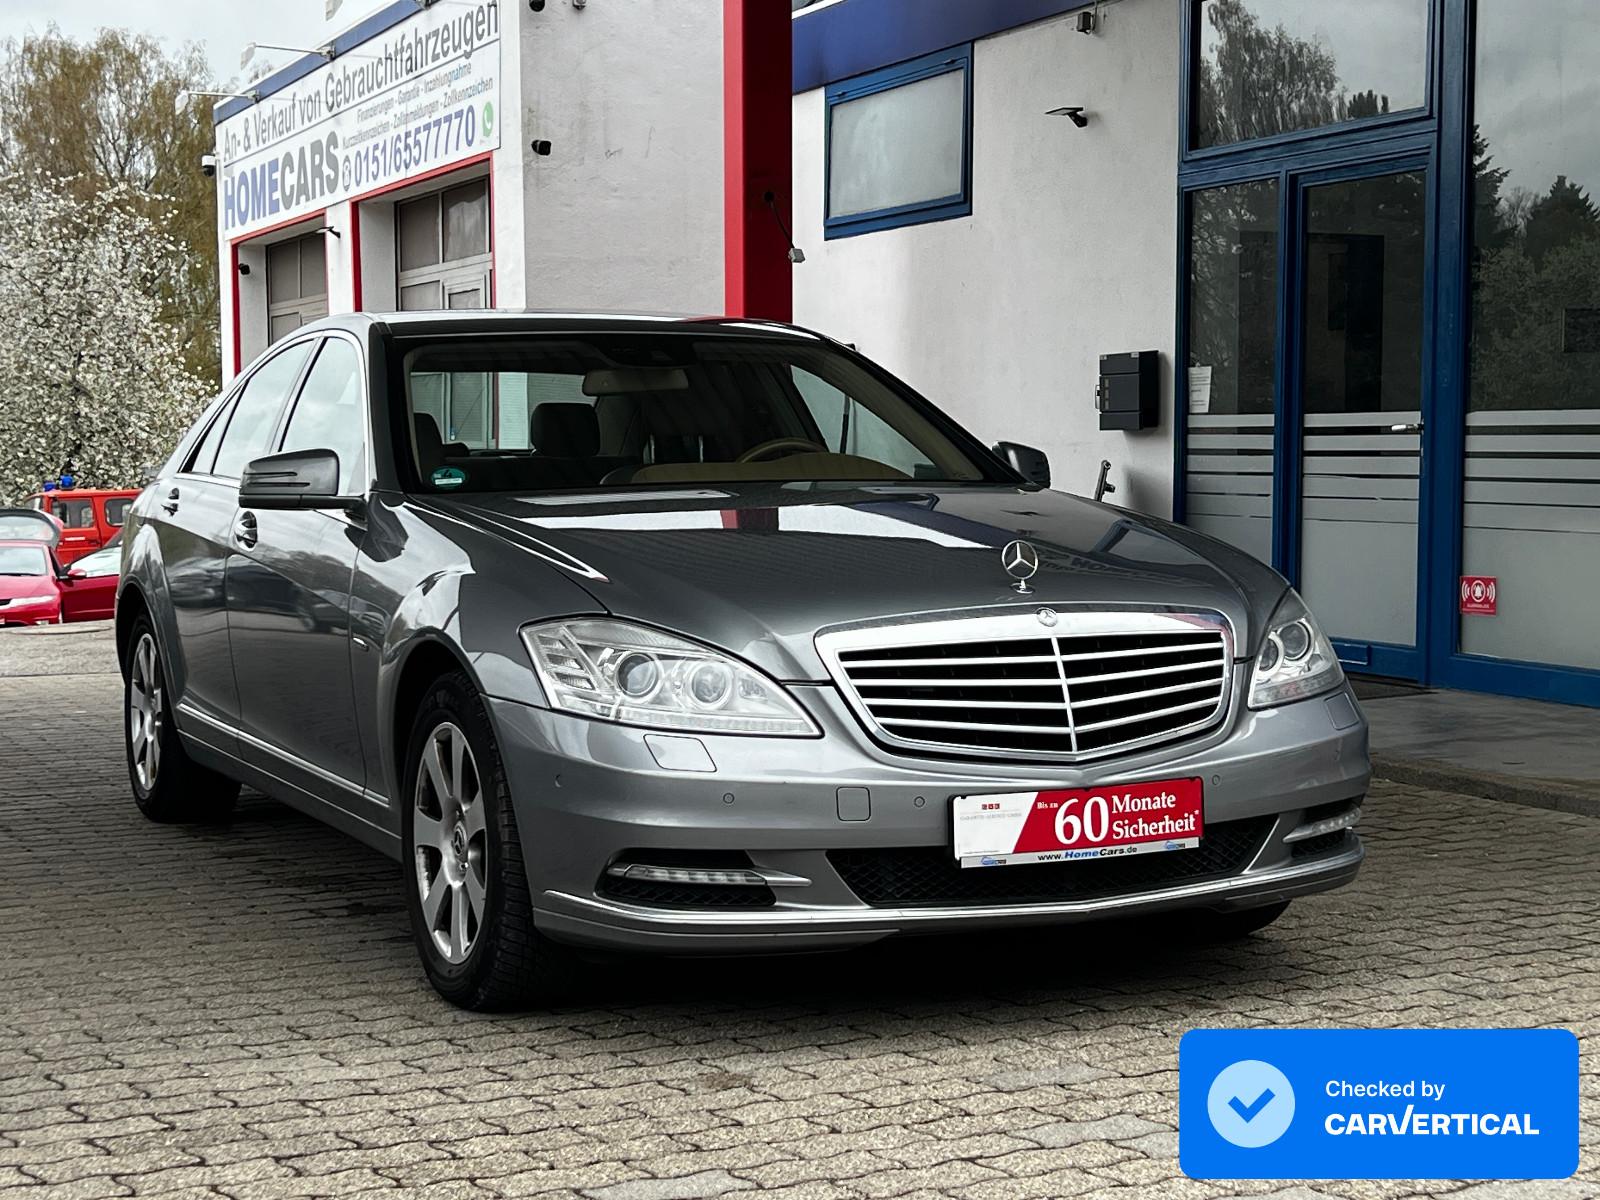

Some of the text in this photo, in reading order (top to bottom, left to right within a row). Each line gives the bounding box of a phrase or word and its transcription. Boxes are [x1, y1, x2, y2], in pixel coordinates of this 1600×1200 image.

[224, 0, 499, 162] An- & Verkauf von Gebrauchtfahrzeugen
[443, 77, 493, 109] Zollkennzeichen
[356, 97, 395, 124] Finanzierungen
[398, 85, 420, 106] Garantie
[354, 104, 475, 188] 0151/65577770
[224, 131, 339, 230] HOMECARS
[1037, 801, 1048, 810] Bis
[1054, 796, 1110, 845] 60
[1112, 792, 1176, 814] Monate
[1037, 846, 1138, 861] www.HomeCars.de
